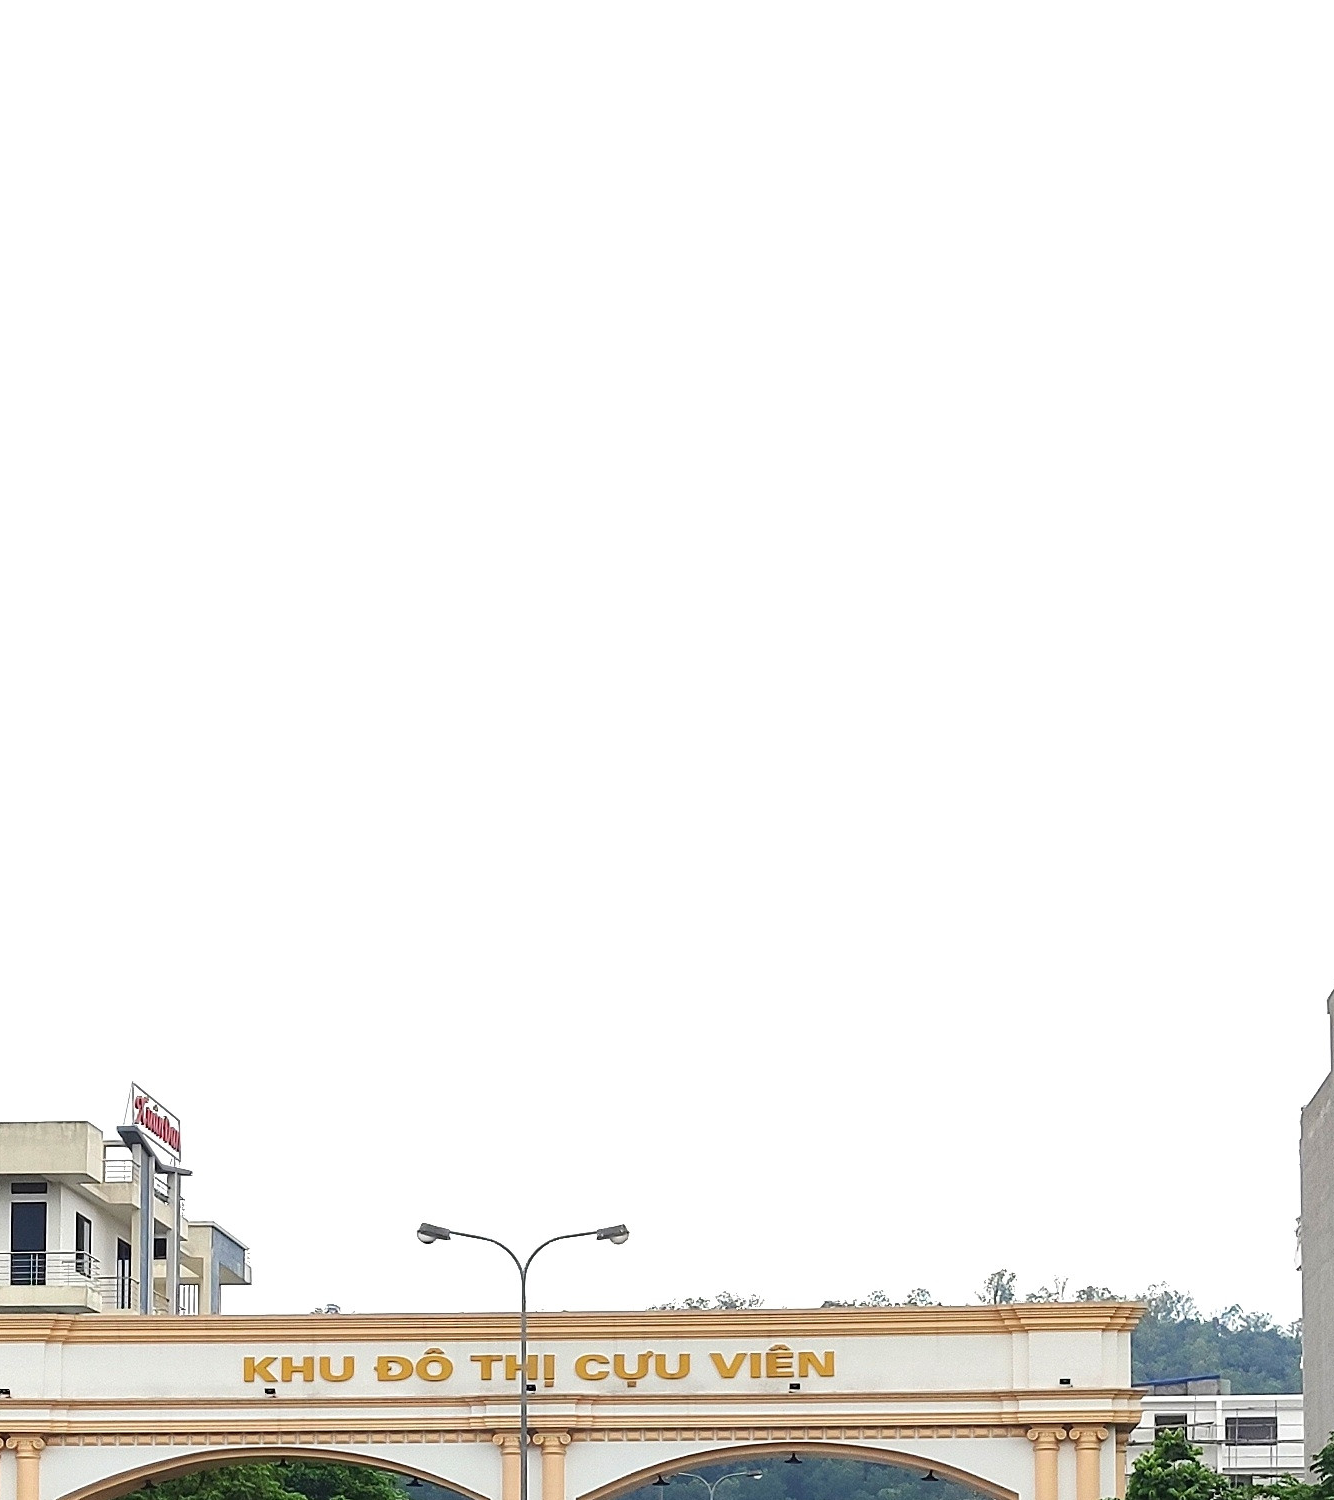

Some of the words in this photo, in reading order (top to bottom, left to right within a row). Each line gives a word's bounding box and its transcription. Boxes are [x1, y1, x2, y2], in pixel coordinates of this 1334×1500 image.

[243, 1356, 355, 1382] KHU
[374, 1347, 454, 1382] ĐÔ
[470, 1354, 555, 1387] THỊ
[574, 1350, 691, 1387] CỰU
[709, 1344, 835, 1379] VIÊN
